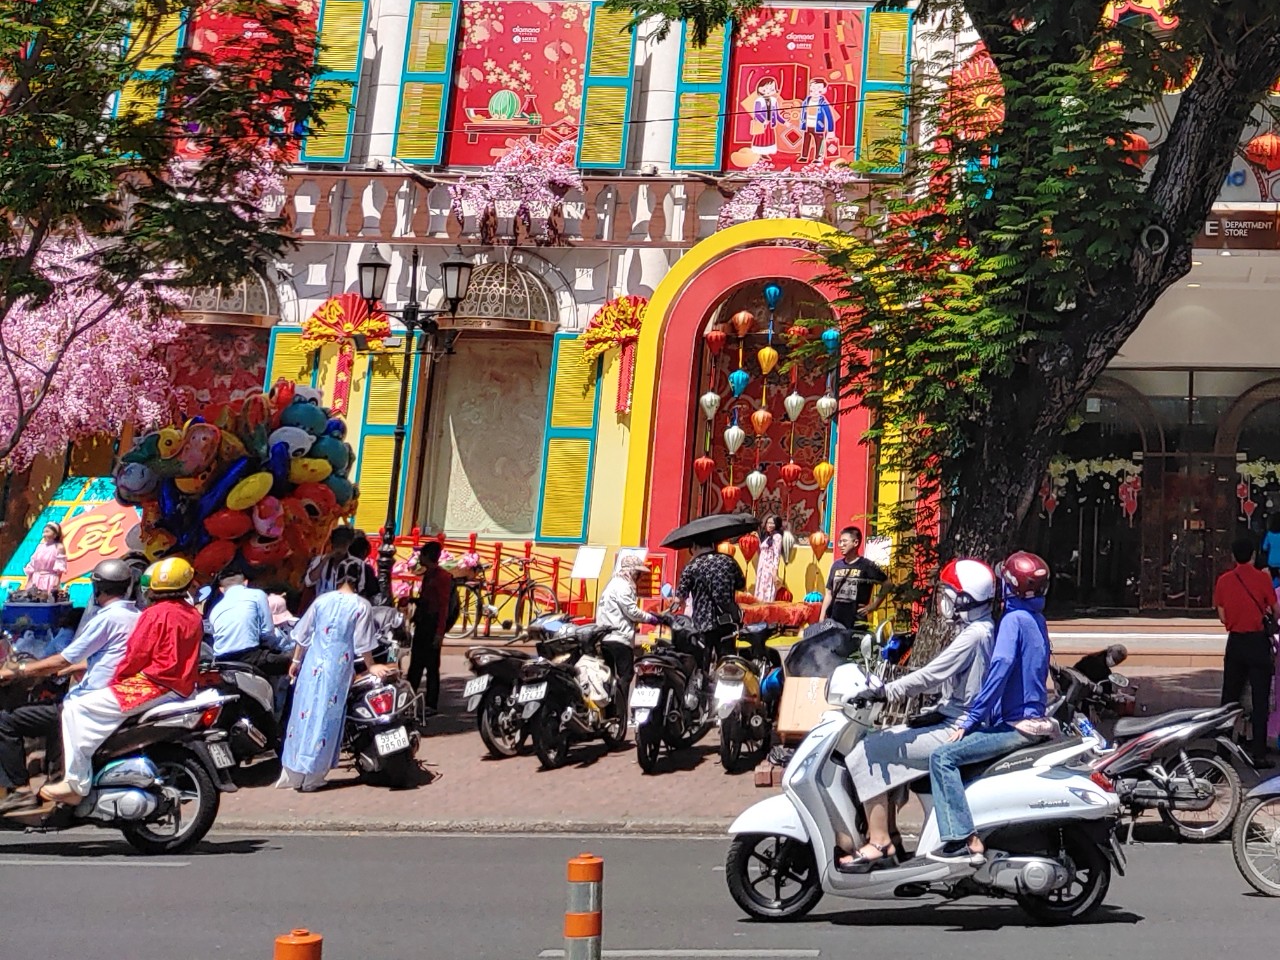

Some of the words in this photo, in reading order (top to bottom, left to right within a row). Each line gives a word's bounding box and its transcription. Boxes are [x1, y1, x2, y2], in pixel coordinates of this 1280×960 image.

[512, 25, 541, 33] diamond
[1225, 221, 1273, 230] DEPARTMENT
[1224, 229, 1248, 237] STORE
[62, 513, 126, 562] Tết
